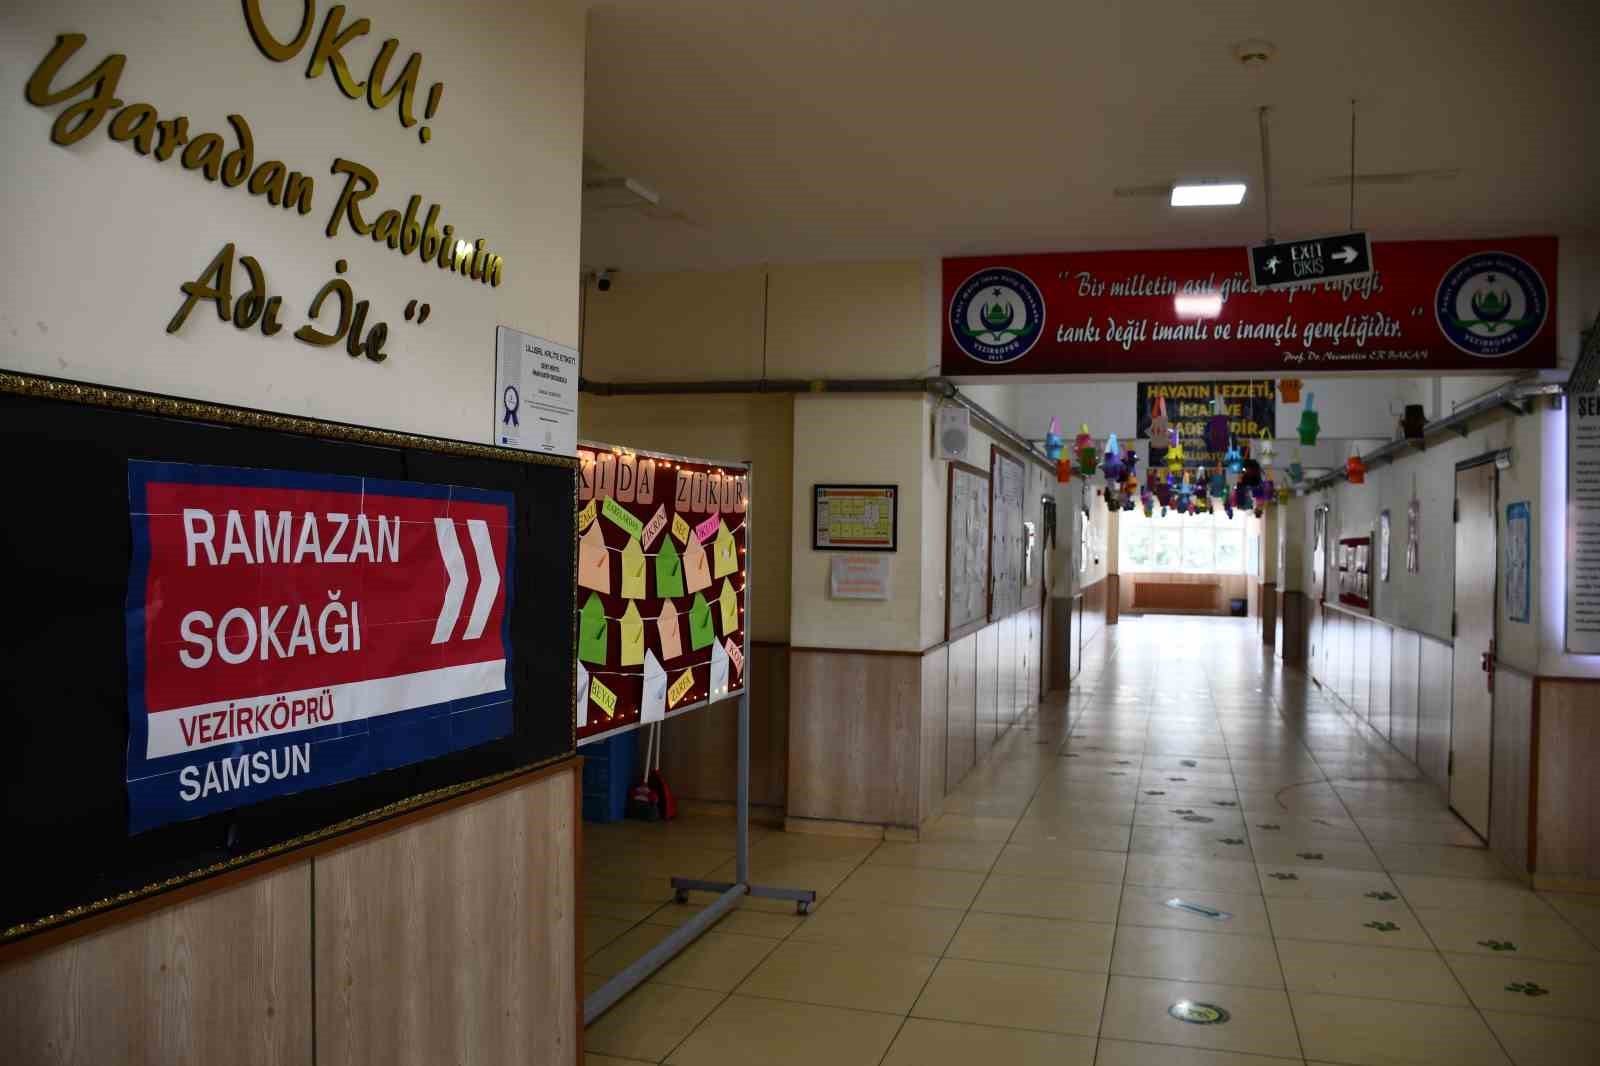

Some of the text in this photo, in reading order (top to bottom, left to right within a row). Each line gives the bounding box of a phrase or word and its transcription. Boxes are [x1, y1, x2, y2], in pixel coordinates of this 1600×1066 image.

[241, 0, 443, 143] OKU!
[24, 33, 503, 287] Yaradan Rabbinin
[1290, 241, 1321, 260] EXIT
[166, 243, 283, 334] Adı
[1110, 273, 1177, 296] milletin
[1057, 317, 1100, 342] tankı
[1106, 318, 1147, 349] değil
[1153, 318, 1207, 341] imanlı
[1214, 324, 1232, 341] ve
[1237, 315, 1297, 346] inançlı
[1147, 385, 1210, 398] HAYATIN
[183, 508, 401, 567] RAMAZAN
[178, 589, 361, 669] SOKAĞI
[179, 688, 334, 748] VEZİRKÖPRÜ
[178, 742, 311, 802] SAMSUN
